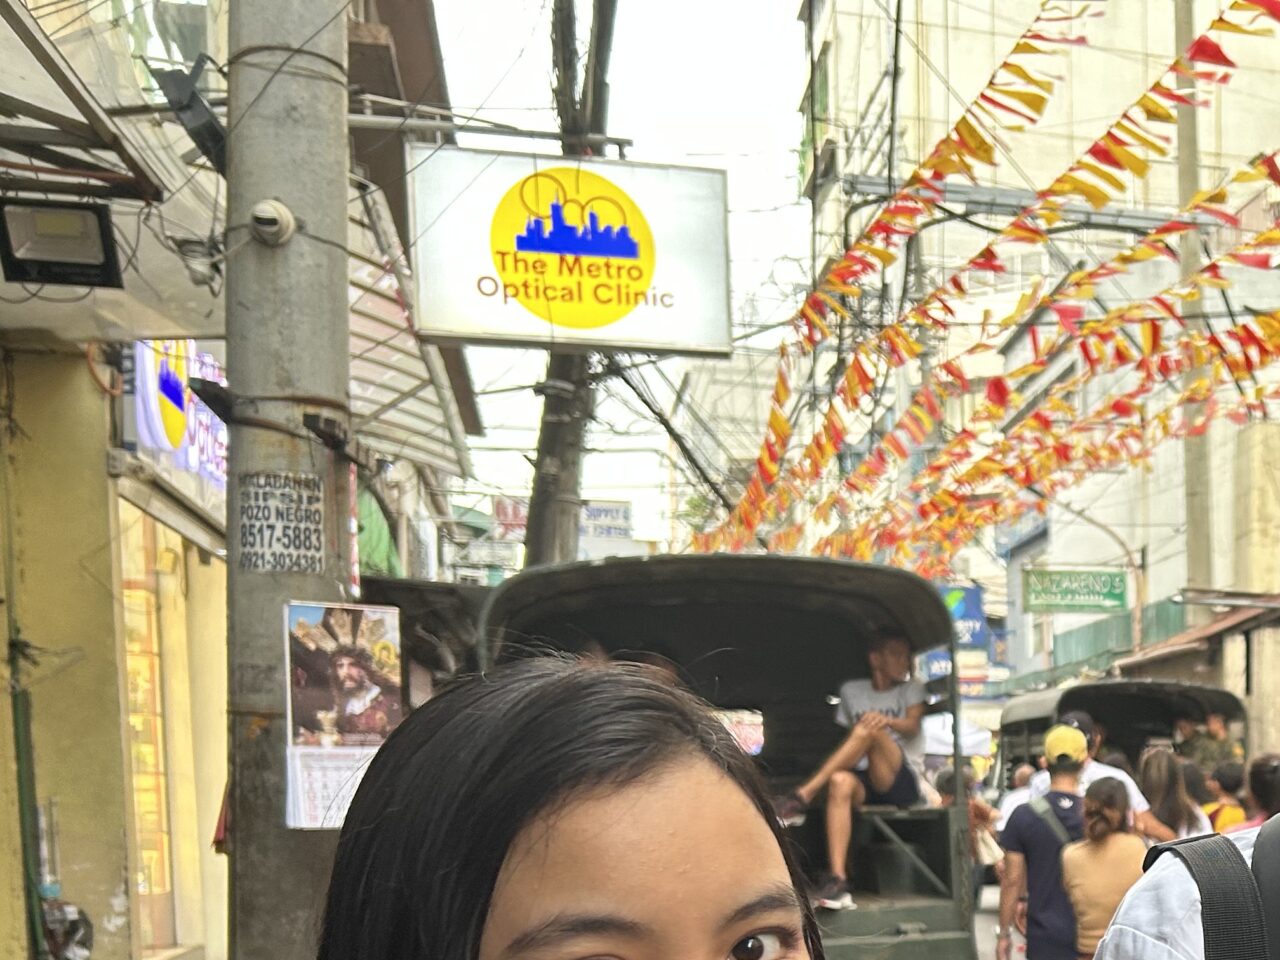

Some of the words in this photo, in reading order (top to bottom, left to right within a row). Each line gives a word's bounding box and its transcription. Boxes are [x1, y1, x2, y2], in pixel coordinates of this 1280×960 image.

[496, 251, 547, 274] The
[558, 254, 643, 281] Metro
[477, 276, 583, 304] Optical
[593, 283, 674, 308] Clinic
[241, 505, 271, 521] POZO
[275, 506, 321, 525] NEGRO
[241, 523, 321, 552] 8517-5883
